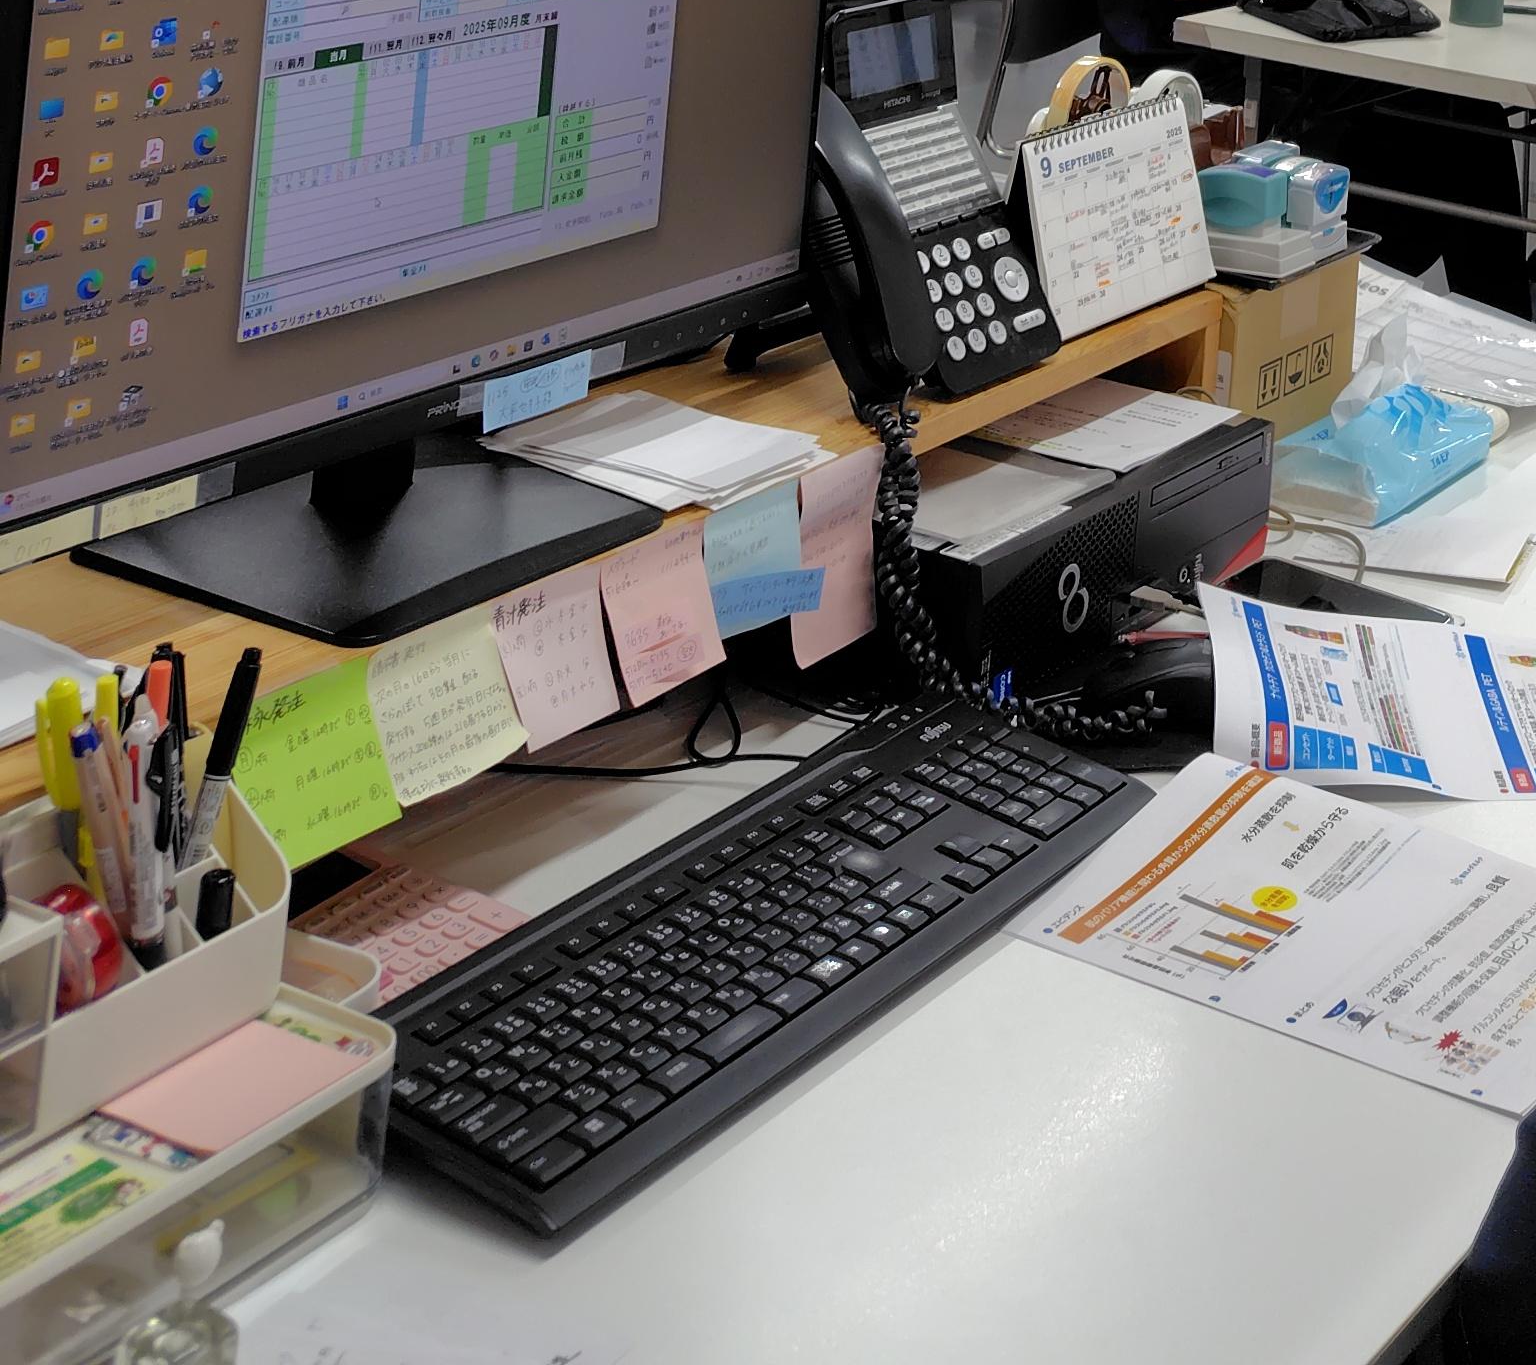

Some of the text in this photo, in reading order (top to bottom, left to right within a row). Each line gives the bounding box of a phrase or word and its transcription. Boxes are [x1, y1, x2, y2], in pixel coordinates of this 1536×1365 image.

[330, 49, 347, 64] 当月
[463, 12, 532, 38] 2025年09月度
[883, 94, 912, 110] HITACHI
[1166, 126, 1183, 139] 2025
[1039, 156, 1053, 179] 9
[1058, 146, 1115, 174] SEPTEMBER
[919, 721, 952, 743] FUJITSU
[1241, 791, 1297, 844] 水分蒸散を抑制
[1281, 806, 1350, 871] 肌を乾燥から守る
